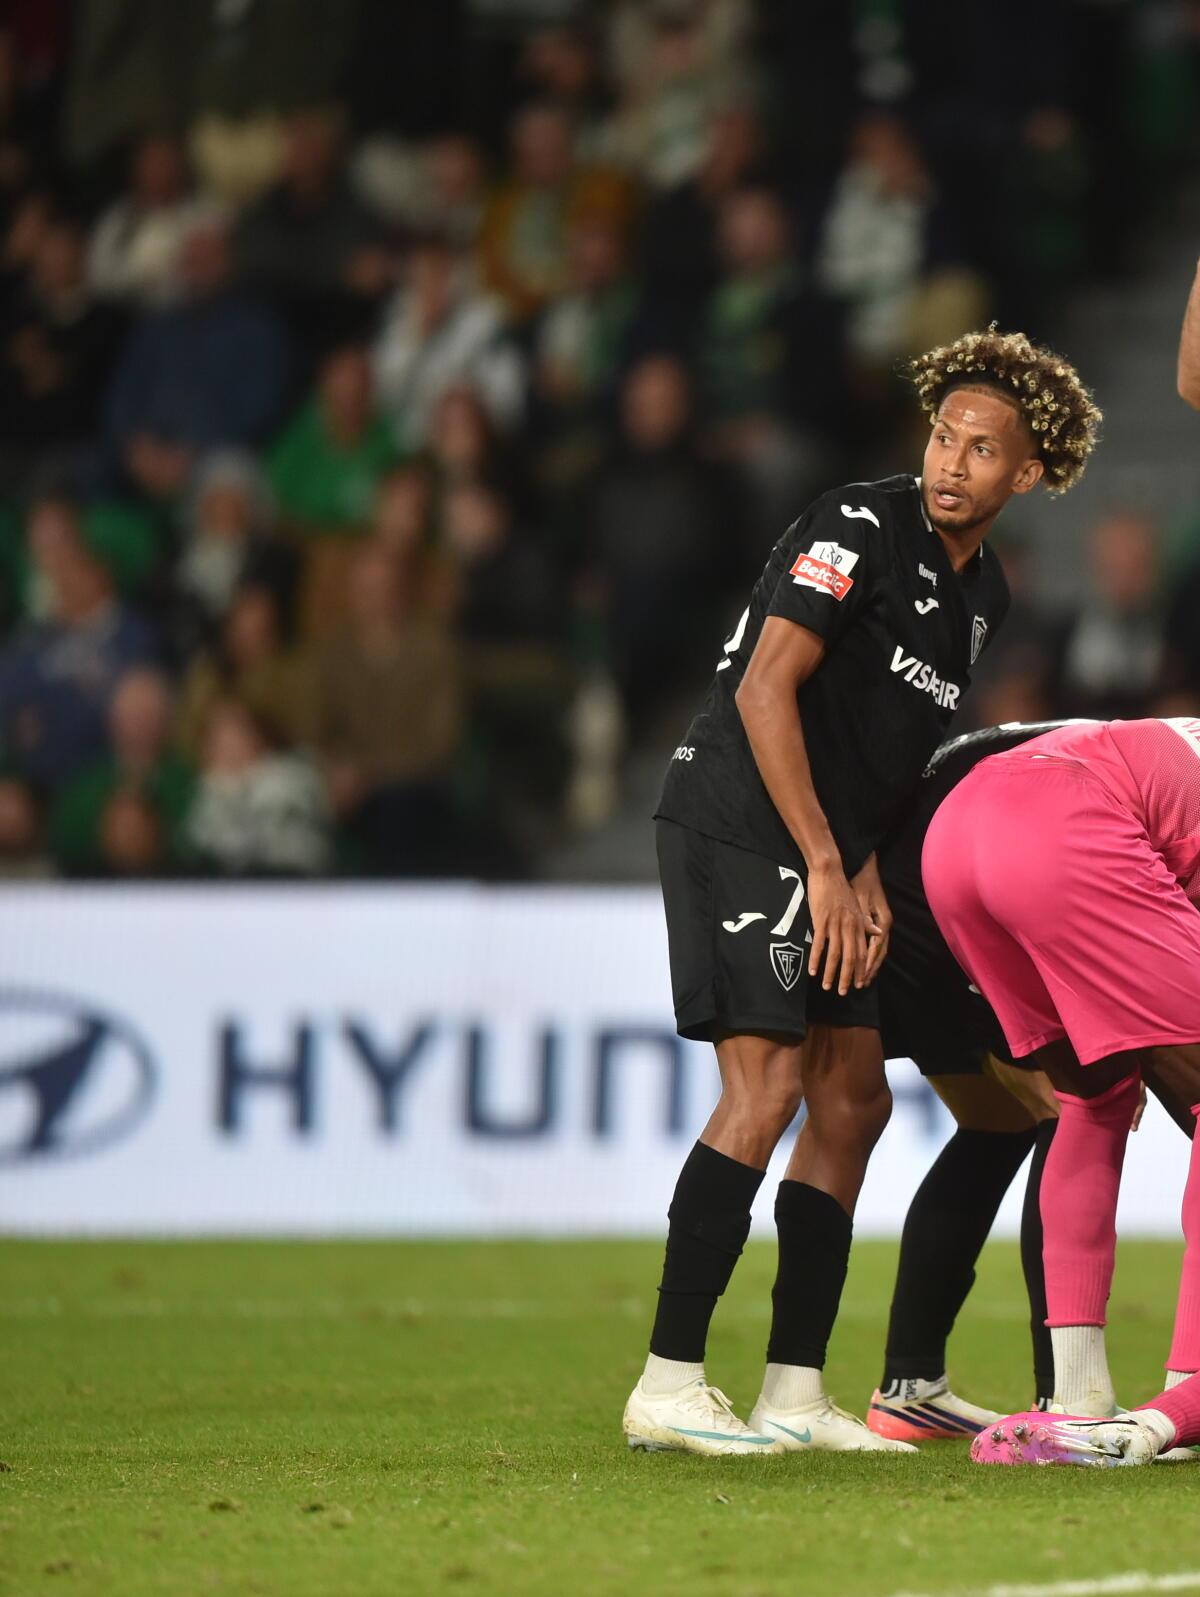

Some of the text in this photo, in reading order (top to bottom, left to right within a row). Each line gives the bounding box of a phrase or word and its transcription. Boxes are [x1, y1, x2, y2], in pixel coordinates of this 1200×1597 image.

[797, 560, 845, 593] Betclic
[770, 866, 813, 944] 7
[216, 1014, 938, 1140] HYUN
